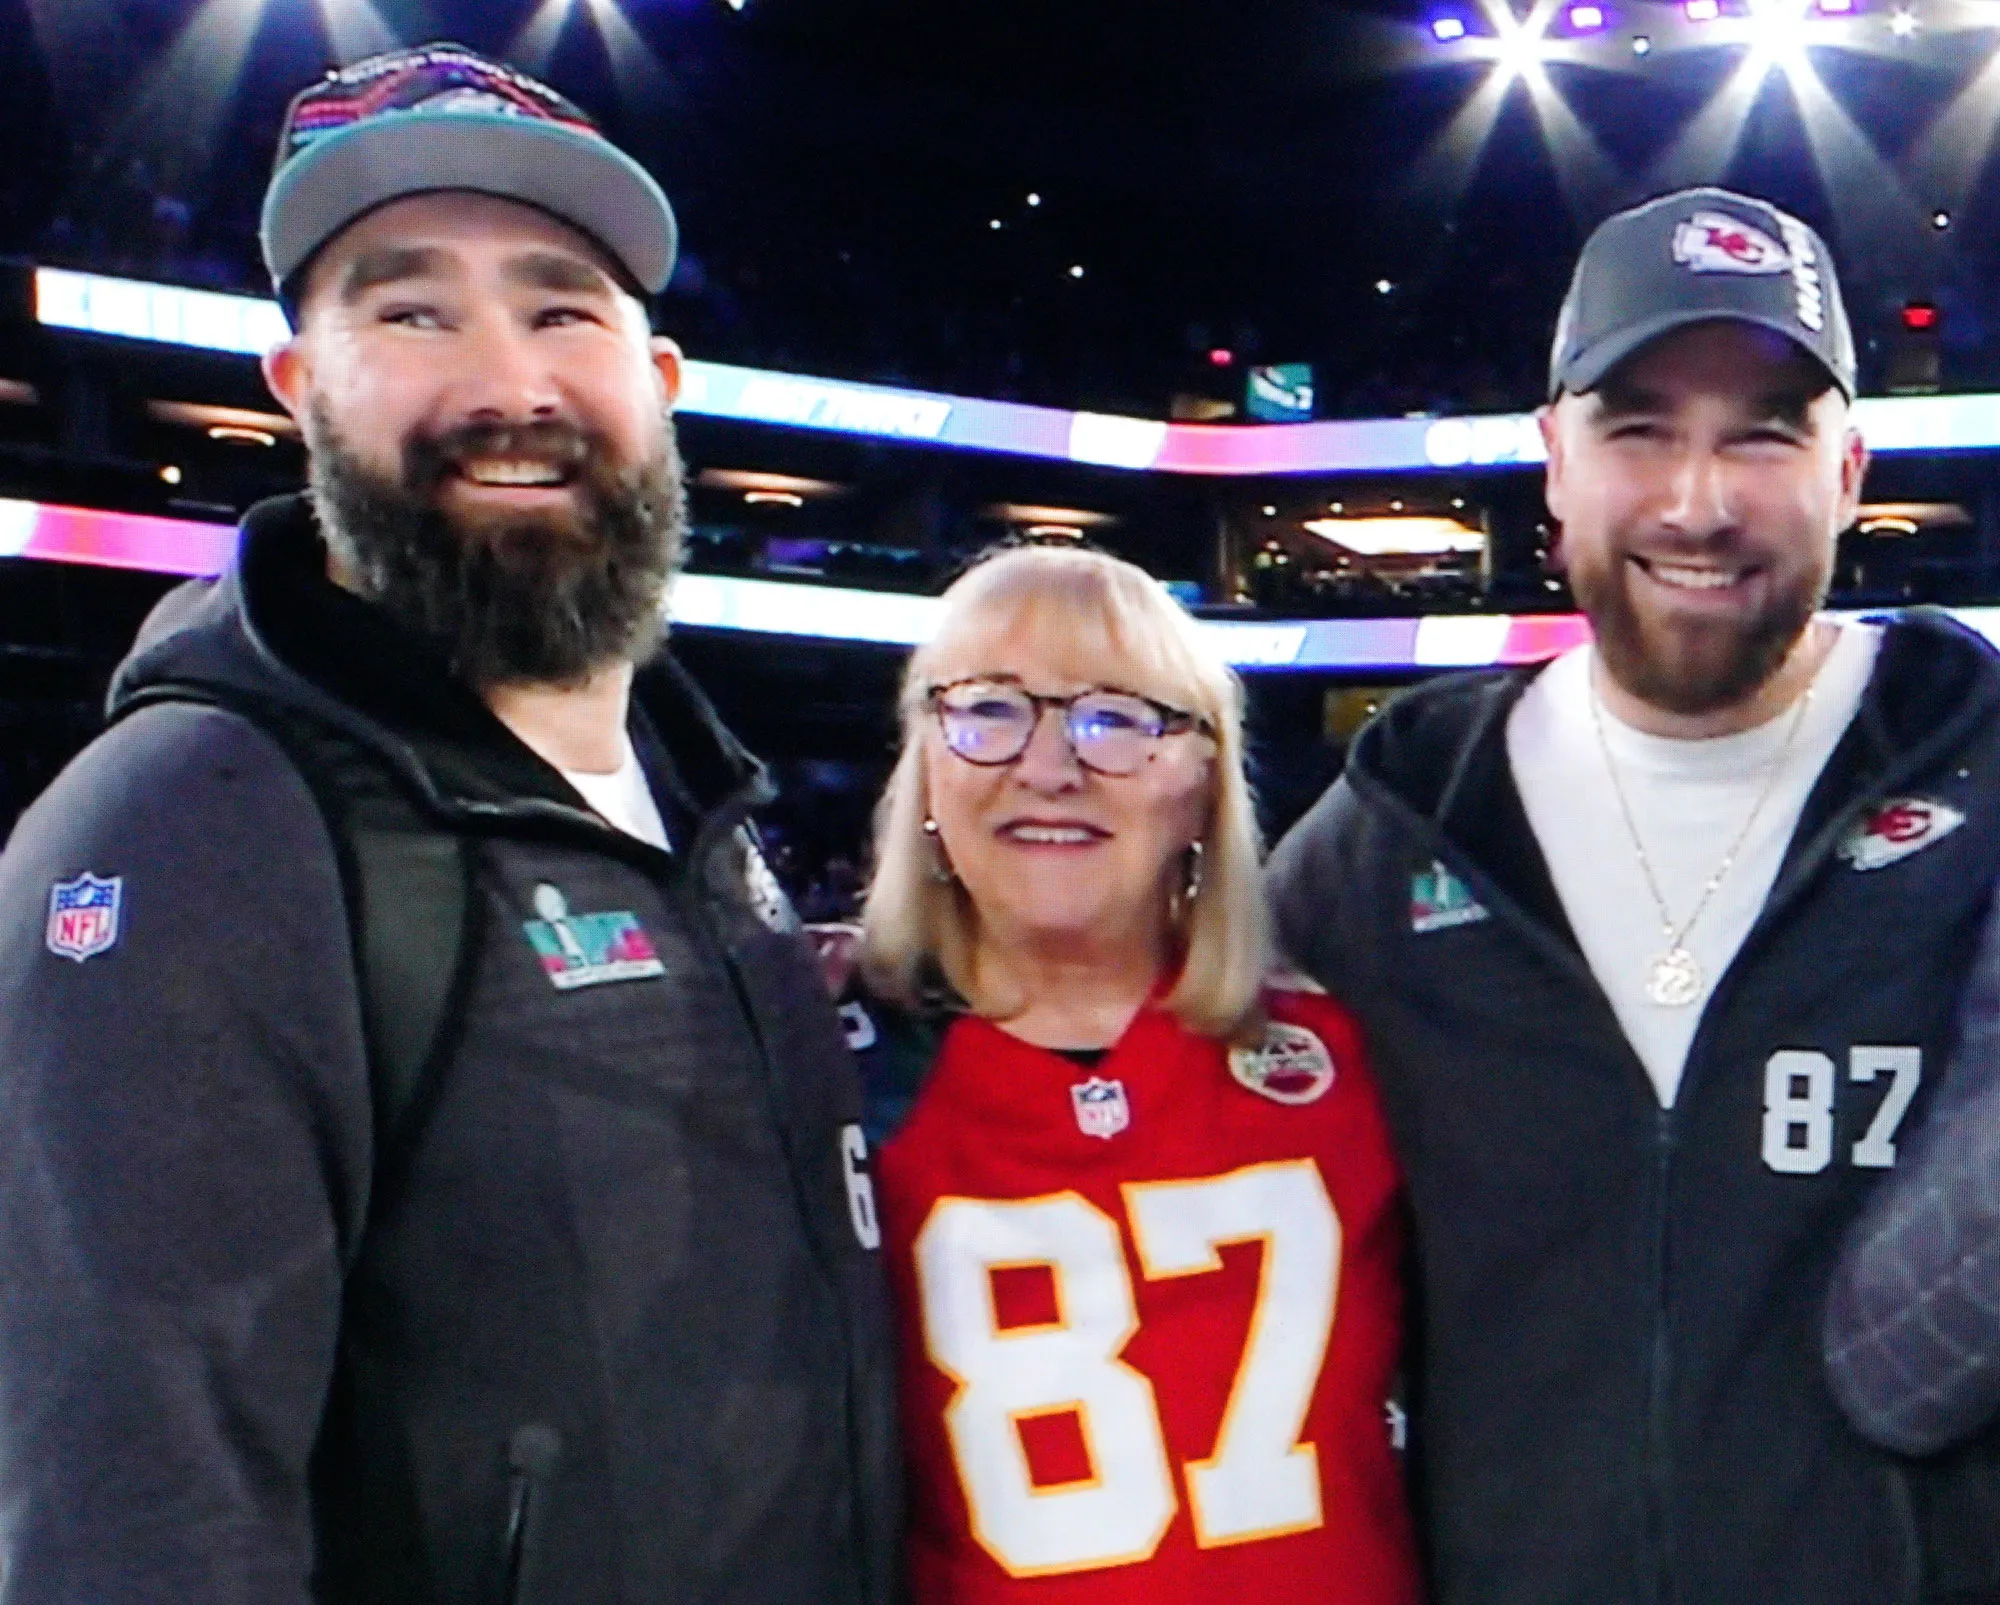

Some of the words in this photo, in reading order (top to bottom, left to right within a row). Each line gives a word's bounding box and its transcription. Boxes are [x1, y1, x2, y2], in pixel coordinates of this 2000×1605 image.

[55, 908, 110, 951] NFL
[1762, 1045, 1922, 1174] 87
[913, 1158, 1343, 1578] 87
